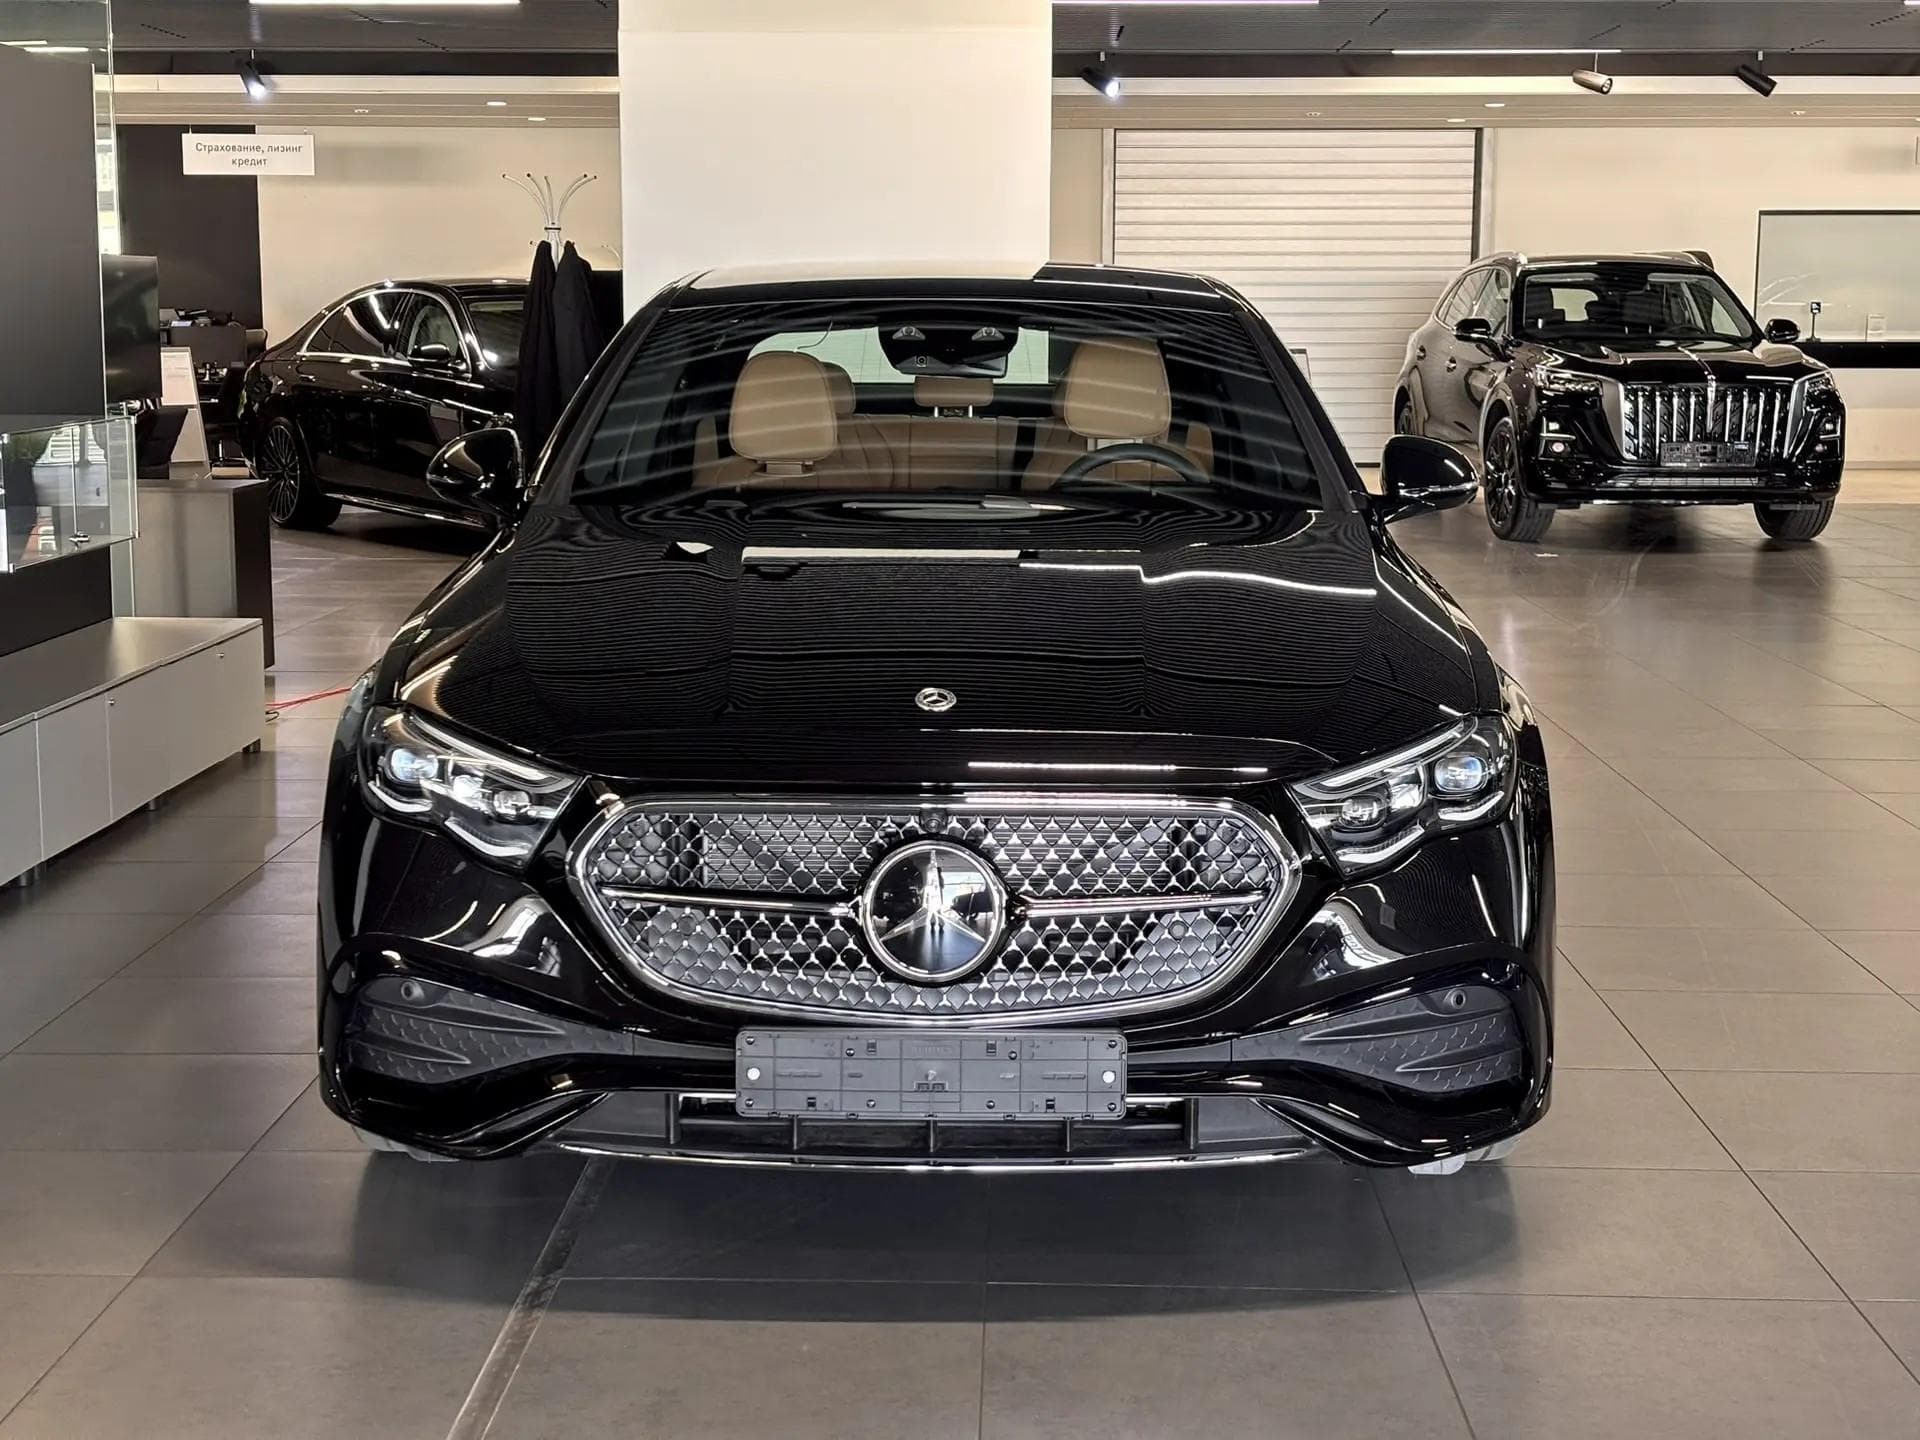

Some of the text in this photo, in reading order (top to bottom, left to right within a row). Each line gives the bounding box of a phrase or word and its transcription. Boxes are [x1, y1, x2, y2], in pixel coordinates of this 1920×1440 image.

[195, 142, 303, 154] Страхование, лизинг
[231, 157, 268, 168] кредит
